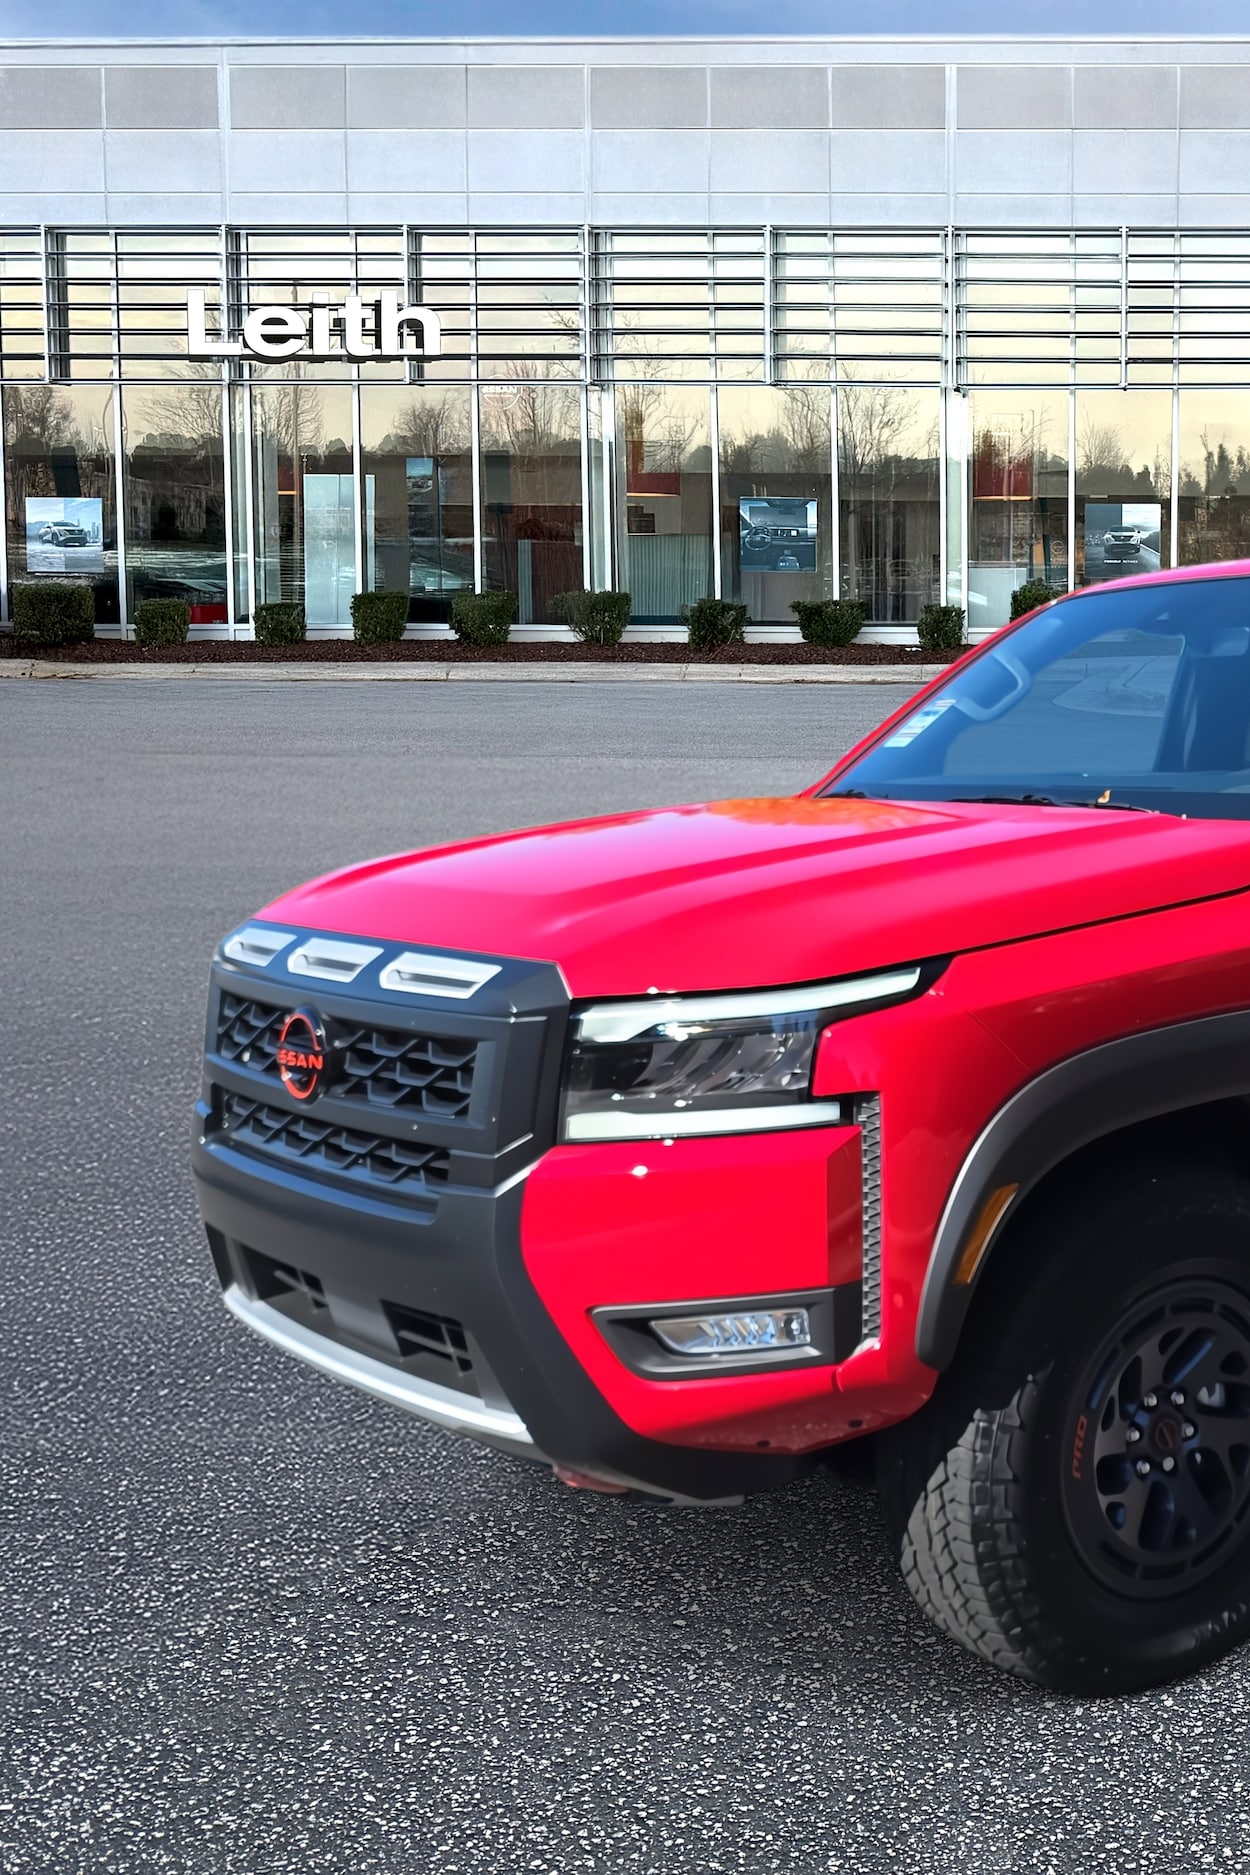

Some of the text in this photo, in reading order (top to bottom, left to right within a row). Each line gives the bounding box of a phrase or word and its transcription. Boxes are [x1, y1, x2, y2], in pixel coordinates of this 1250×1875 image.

[187, 289, 441, 357] Leith
[277, 1048, 323, 1069] SSAN
[1072, 1415, 1088, 1479] PRO
